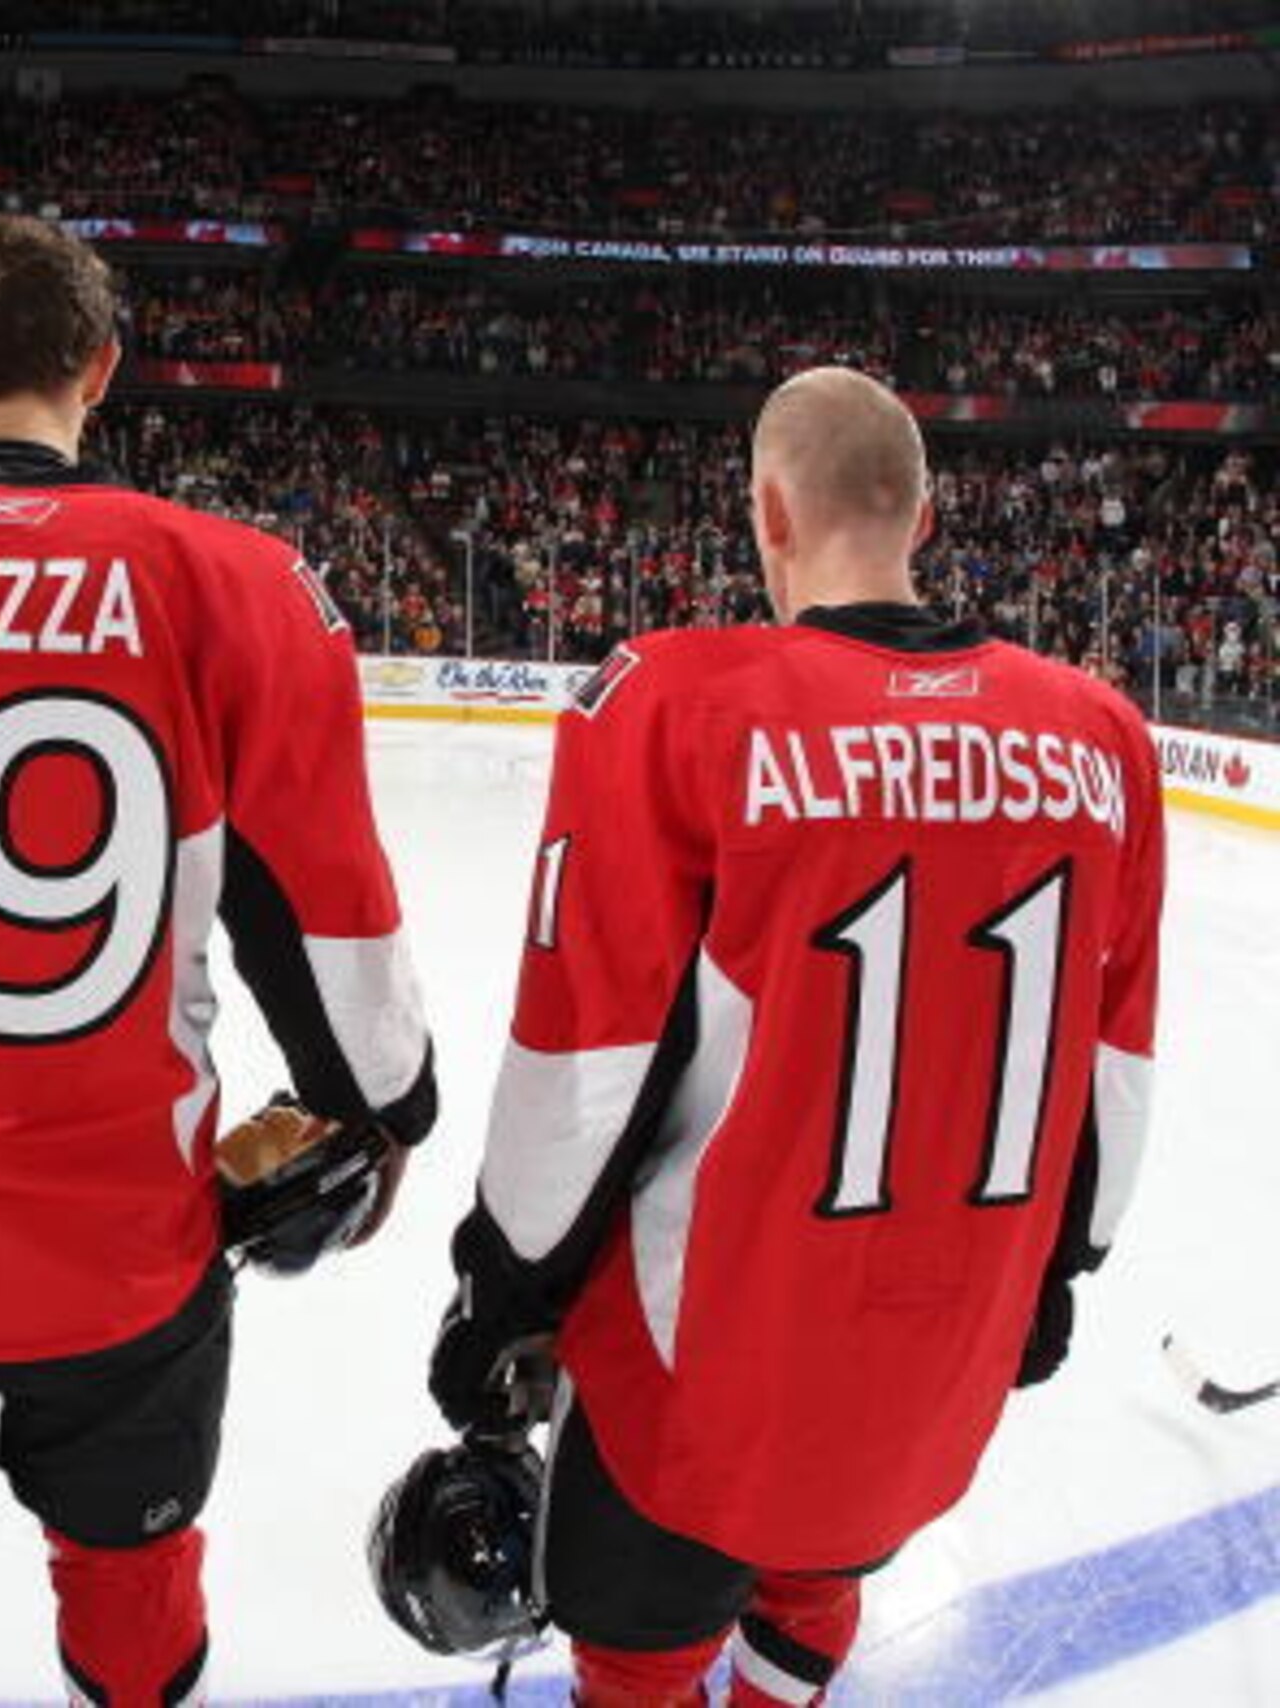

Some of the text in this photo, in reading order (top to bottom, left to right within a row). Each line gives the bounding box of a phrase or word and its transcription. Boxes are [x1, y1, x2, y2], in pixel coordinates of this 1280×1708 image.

[908, 247, 949, 267] FOR
[744, 722, 1126, 843] ALFREDSSON
[809, 855, 1073, 1218] 11
